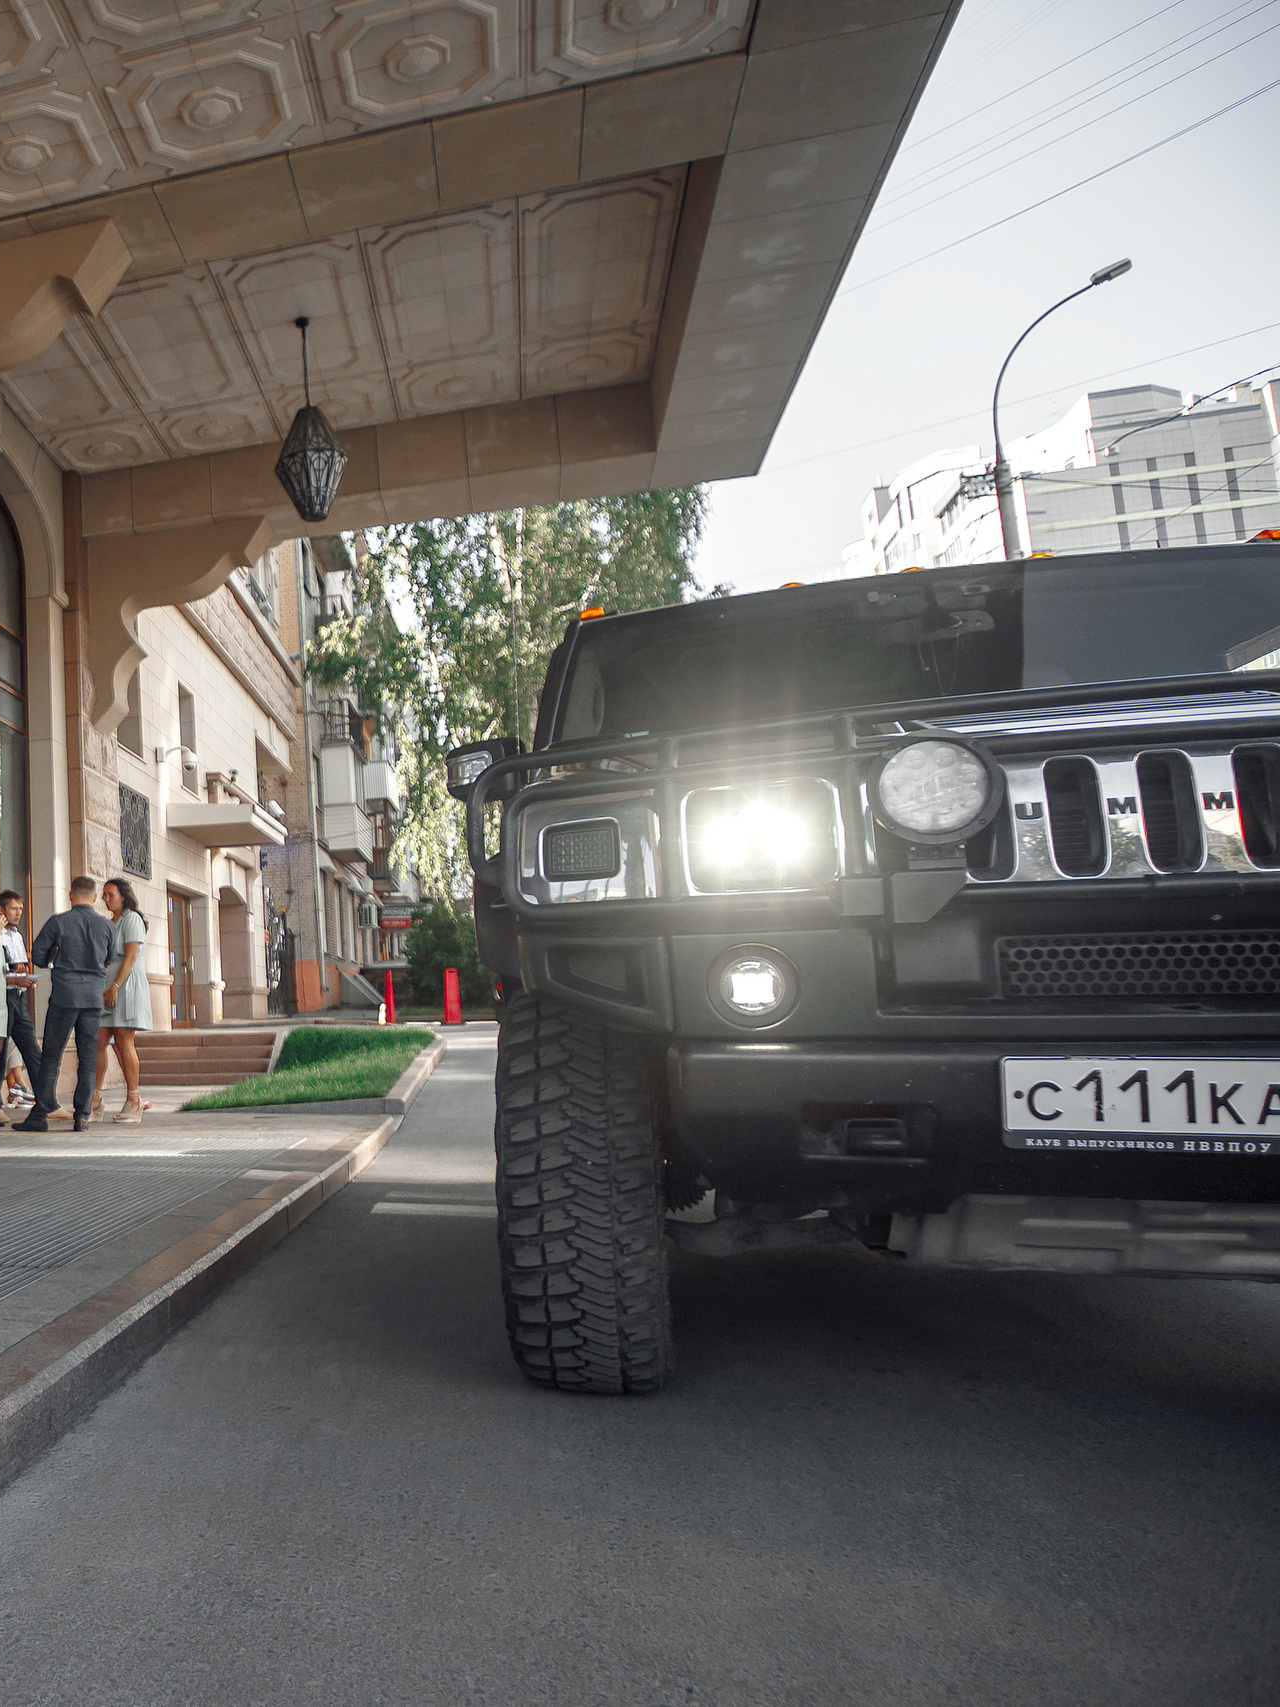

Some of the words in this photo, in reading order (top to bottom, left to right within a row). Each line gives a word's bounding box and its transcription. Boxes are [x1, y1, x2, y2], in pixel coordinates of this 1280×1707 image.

[1025, 1137, 1061, 1148] КЛУБ
[1067, 1139, 1175, 1150] ВЫПУСКНИКОВ
[1182, 1140, 1272, 1153] НВВПОУ
